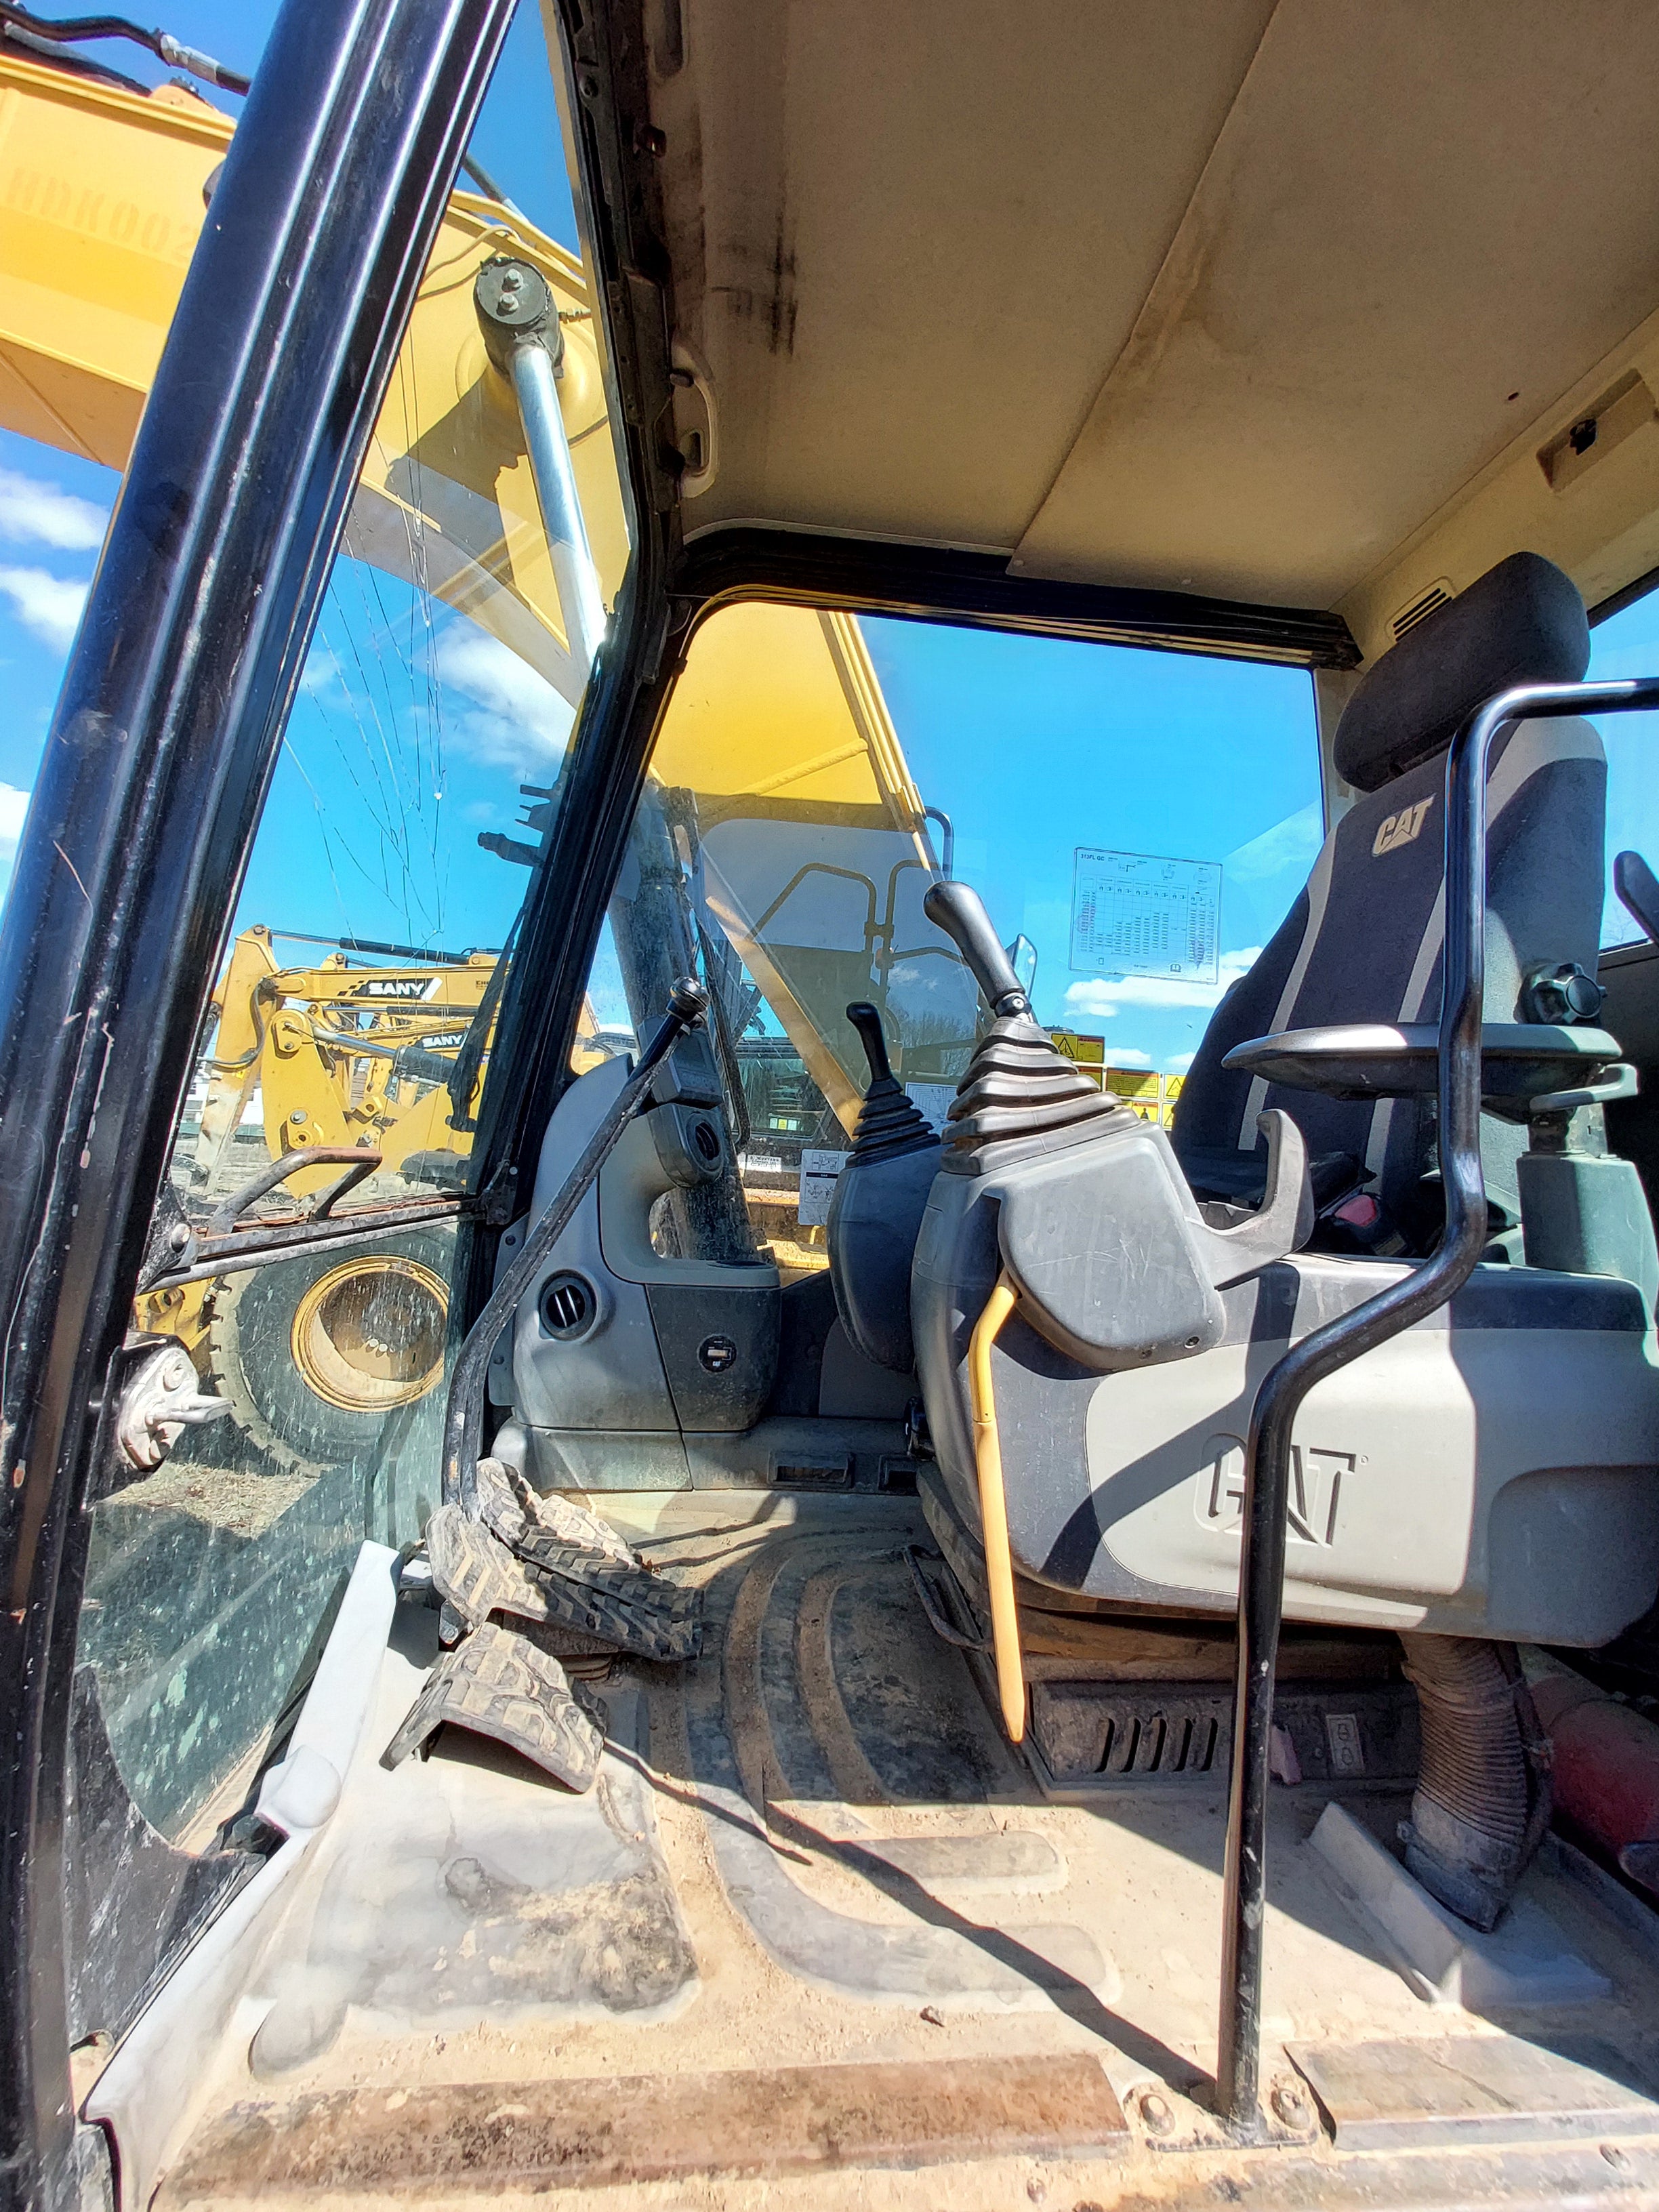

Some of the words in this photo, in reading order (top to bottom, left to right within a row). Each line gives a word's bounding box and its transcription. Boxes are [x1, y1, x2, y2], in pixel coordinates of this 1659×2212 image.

[1372, 793, 1436, 857] CAT
[369, 983, 424, 995] SANY
[422, 1035, 462, 1047] SANY
